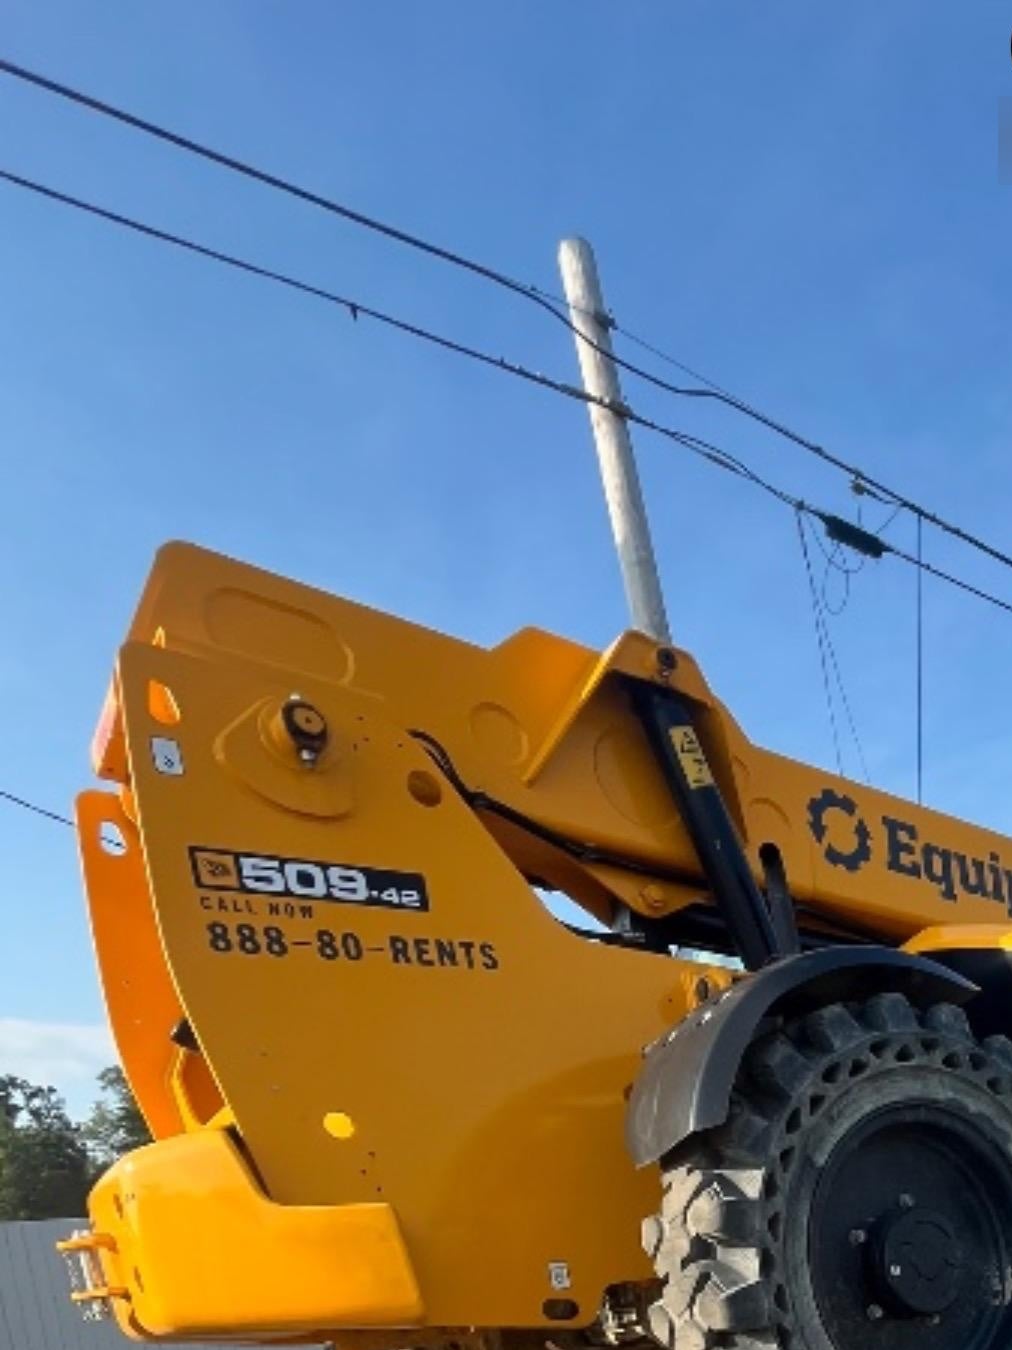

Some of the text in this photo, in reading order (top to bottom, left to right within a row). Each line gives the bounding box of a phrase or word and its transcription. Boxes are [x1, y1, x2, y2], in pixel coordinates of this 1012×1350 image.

[200, 896, 313, 918] CALL NOW
[207, 922, 498, 970] 888-80-RENTS
